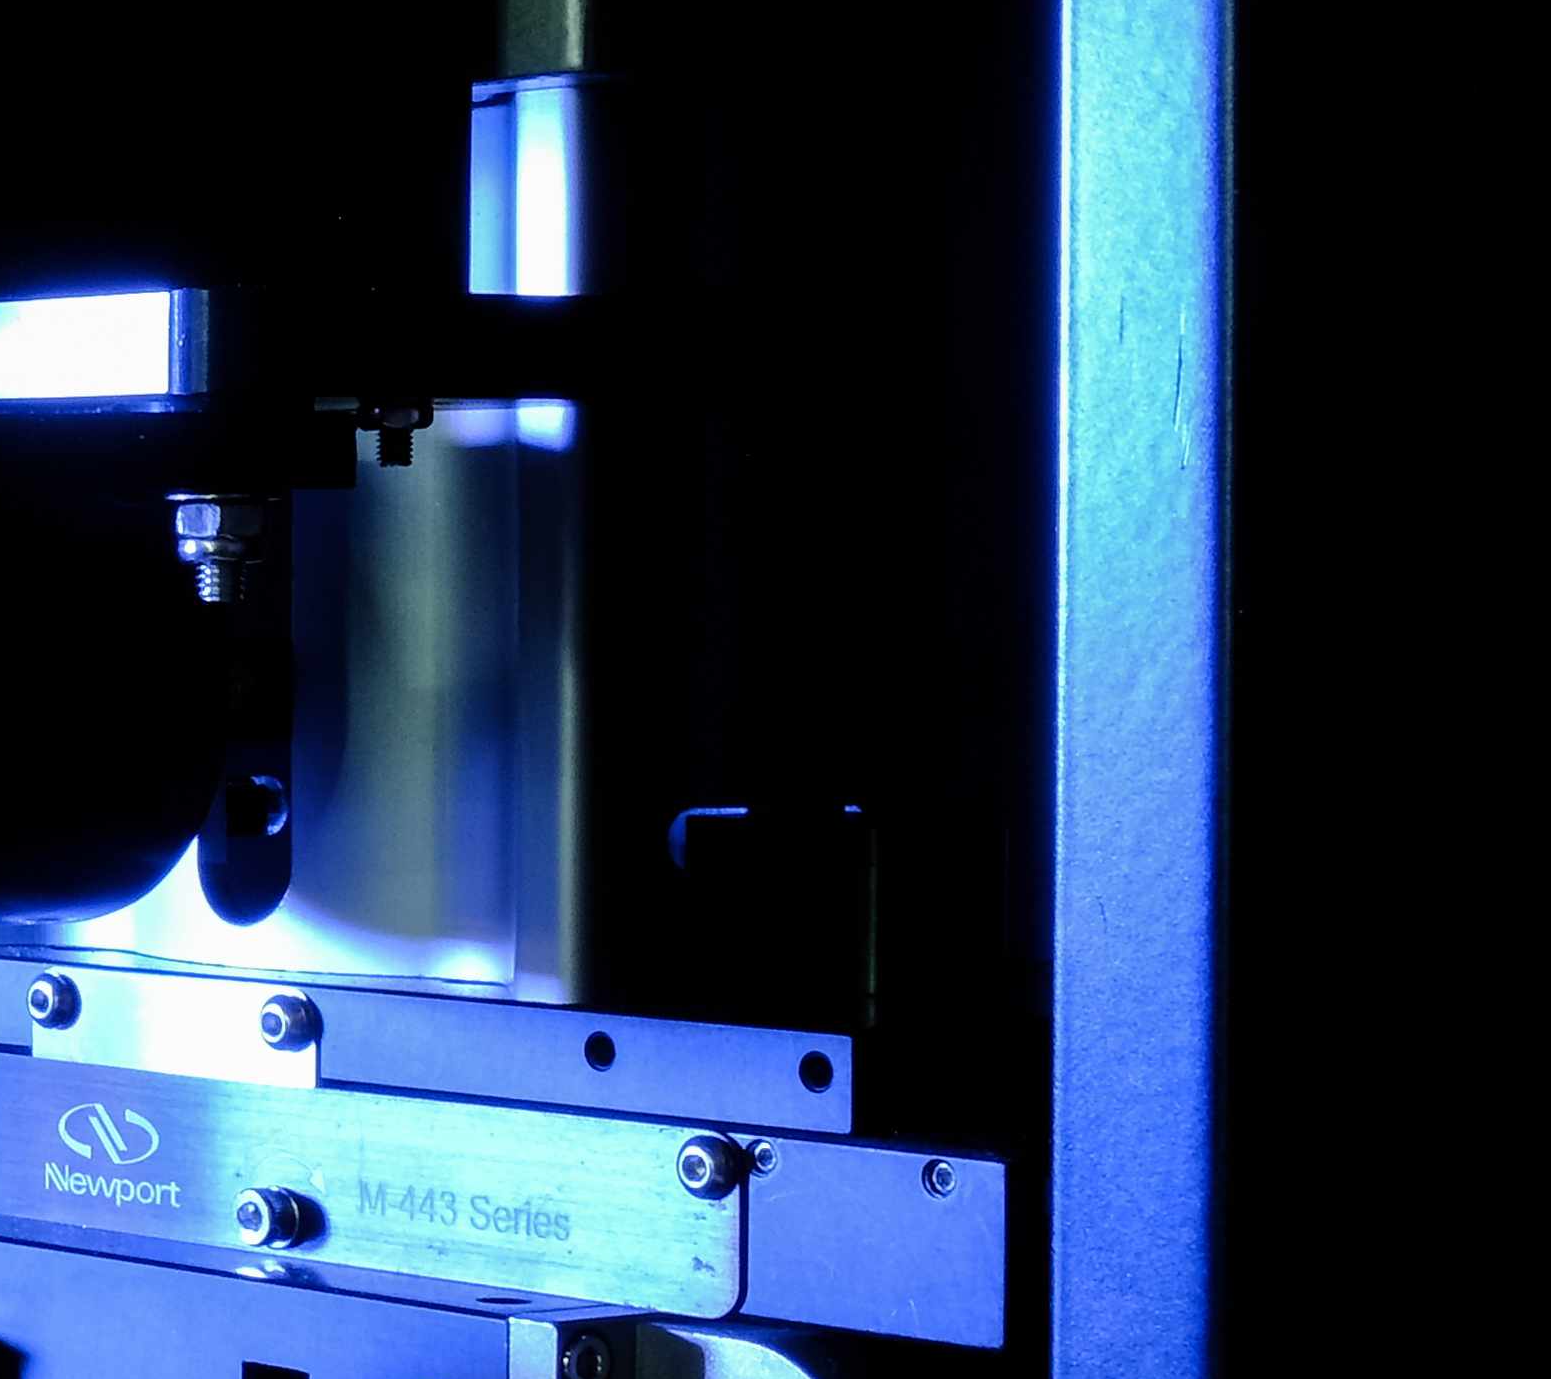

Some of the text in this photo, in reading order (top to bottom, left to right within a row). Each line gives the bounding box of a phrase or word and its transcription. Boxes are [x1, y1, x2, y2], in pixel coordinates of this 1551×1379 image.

[44, 1162, 182, 1208] Newport
[358, 1179, 571, 1242] M-443 Series
